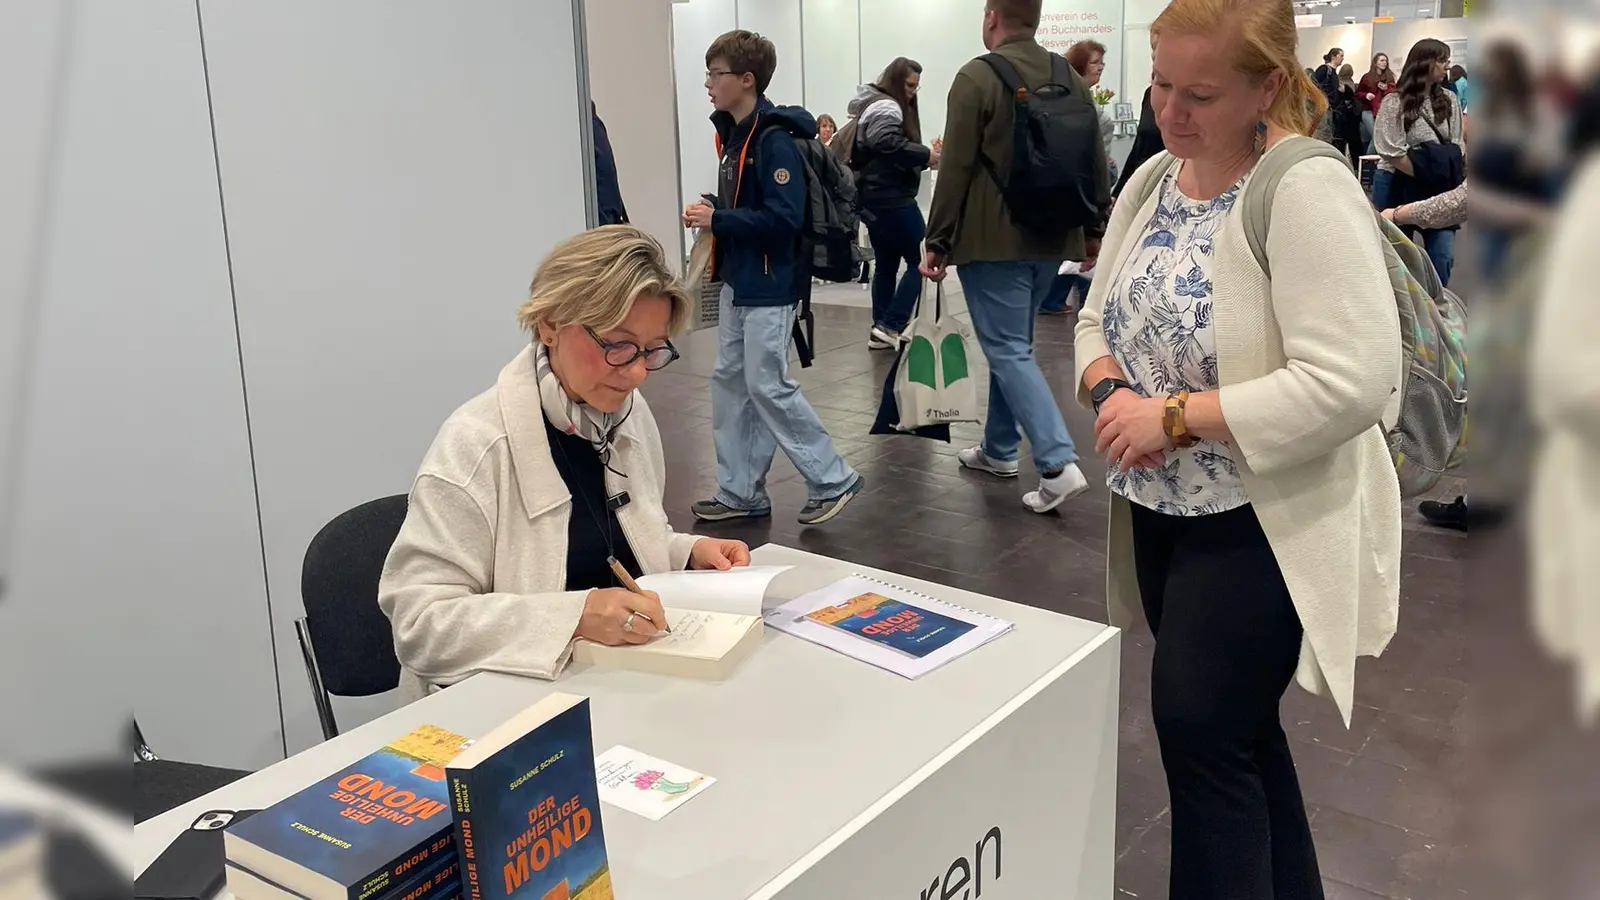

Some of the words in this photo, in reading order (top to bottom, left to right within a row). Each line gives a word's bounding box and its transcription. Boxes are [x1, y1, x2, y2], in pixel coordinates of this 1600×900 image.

[1051, 24, 1116, 34] Buchhandels-
[1081, 11, 1099, 20] des
[933, 408, 960, 418] Thalia
[861, 610, 919, 634] MOND
[509, 766, 539, 791] SUSANNE
[540, 750, 564, 771] SCHULZ
[329, 790, 415, 826] UNHEILIGE
[337, 773, 448, 820] MOND
[453, 778, 463, 812] SUSANNE
[461, 784, 470, 813] SCHULZ
[340, 807, 377, 825] DER
[527, 795, 556, 824] DER
[290, 821, 319, 838] SCHULZ
[318, 831, 352, 849] SUSANNE
[462, 820, 475, 858] MOND
[506, 794, 580, 858] UNHEILIGE
[394, 849, 429, 876] MOND
[503, 807, 592, 895] MOND
[363, 871, 389, 891] SCHULZ
